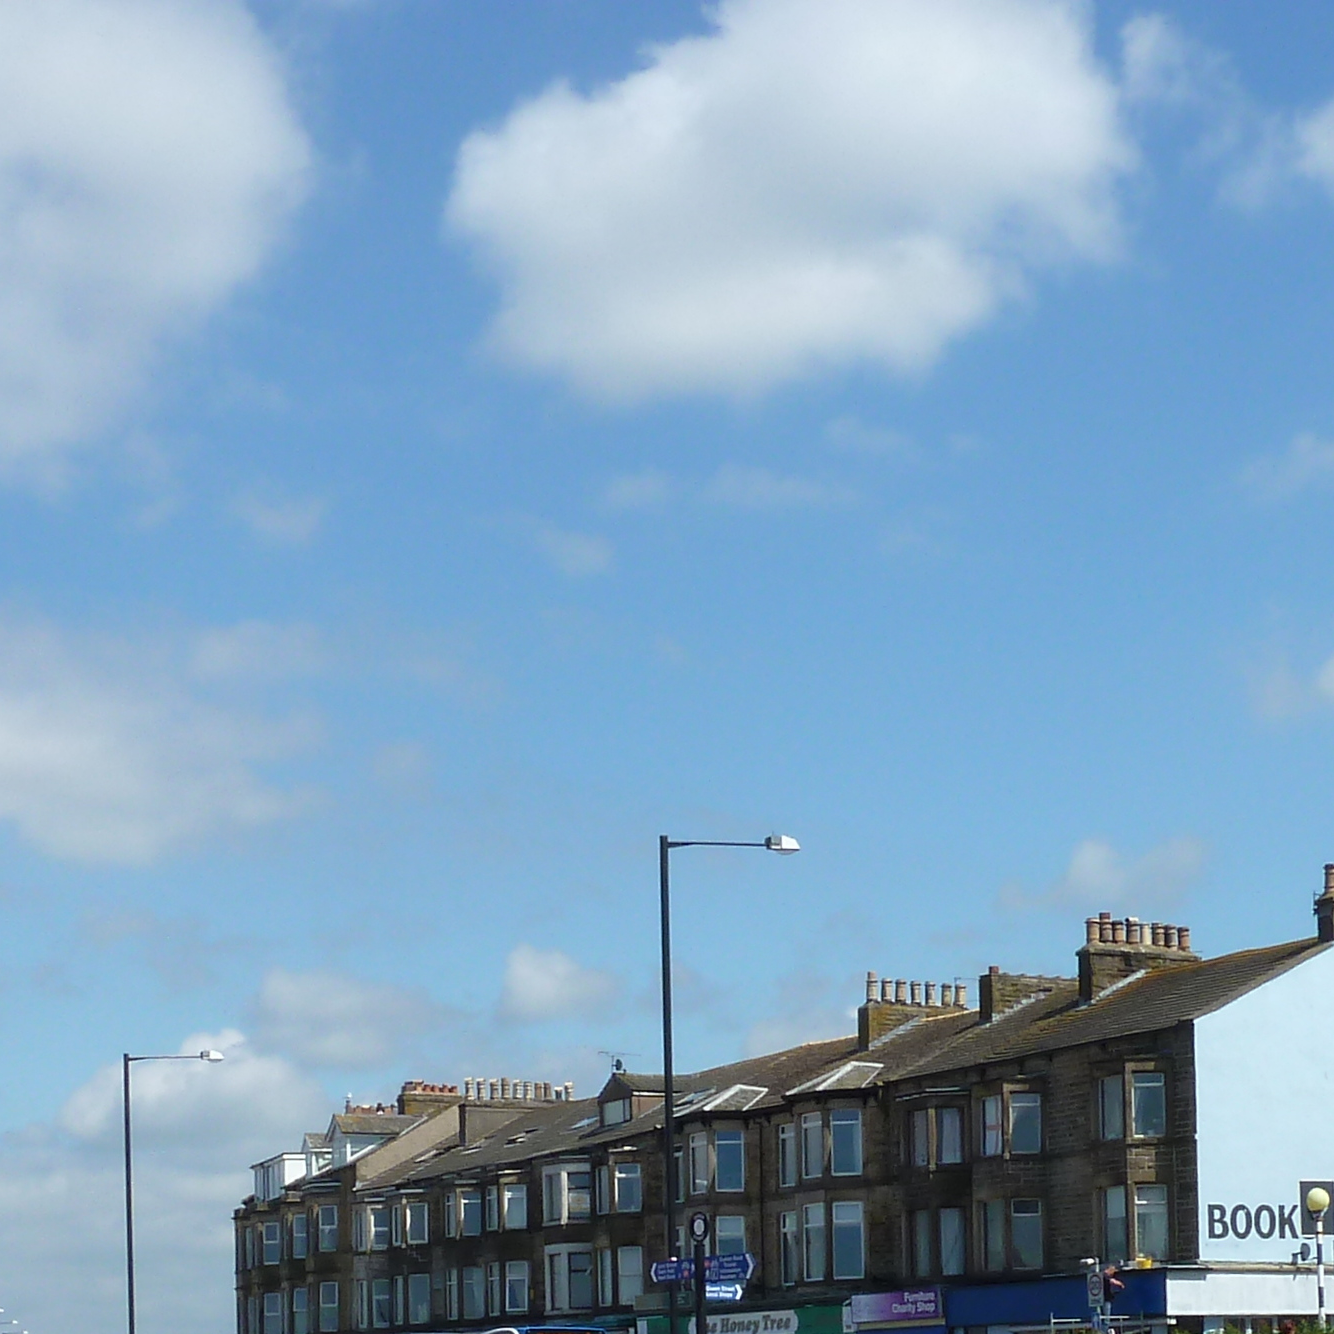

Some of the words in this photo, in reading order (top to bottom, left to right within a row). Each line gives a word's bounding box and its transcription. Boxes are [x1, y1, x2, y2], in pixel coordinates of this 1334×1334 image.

[1207, 1203, 1317, 1240] BOOK
[903, 1291, 936, 1303] Furniture
[891, 1302, 916, 1315] Charity
[917, 1301, 936, 1313] Shop
[762, 1314, 791, 1331] Tree
